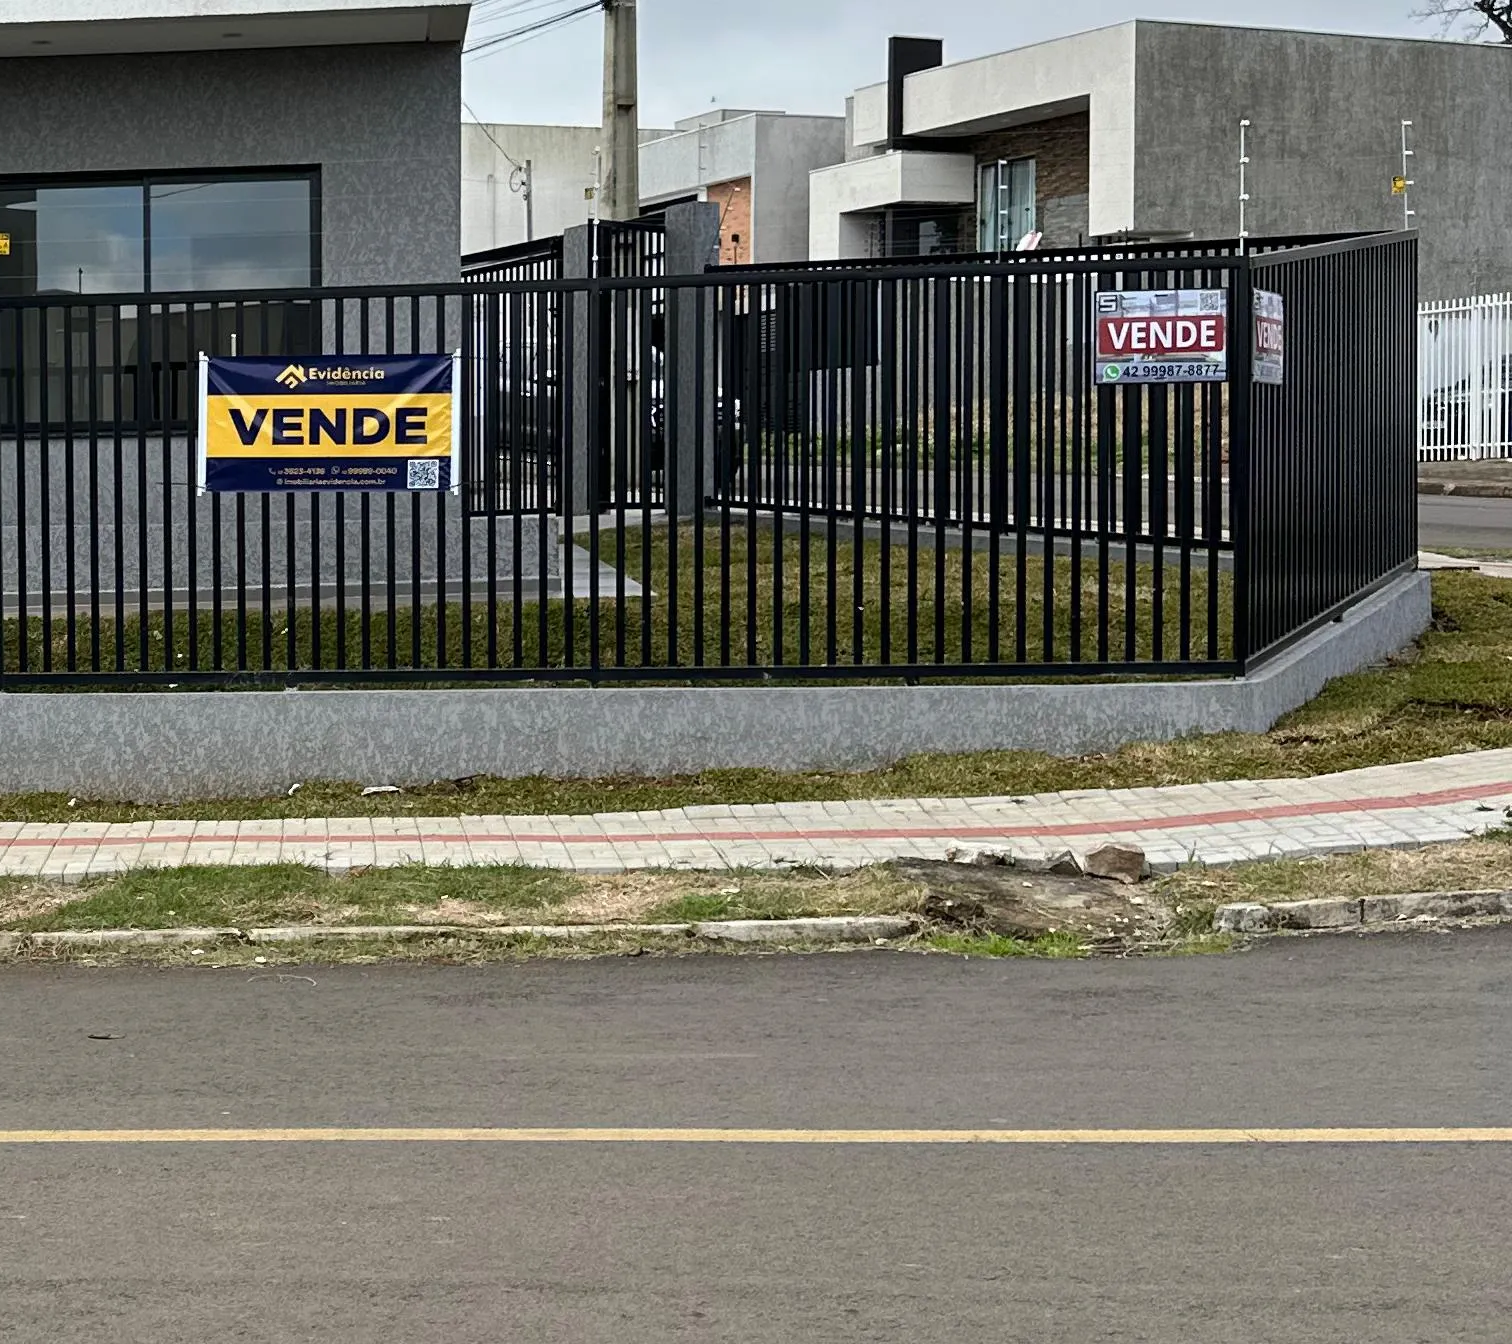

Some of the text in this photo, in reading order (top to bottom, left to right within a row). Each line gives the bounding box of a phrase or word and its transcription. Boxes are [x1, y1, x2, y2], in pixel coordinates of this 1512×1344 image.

[1107, 319, 1216, 350] VENDE
[308, 366, 385, 380] Evidência
[1122, 364, 1219, 377] 42 99987-8877
[228, 407, 428, 446] VENDE
